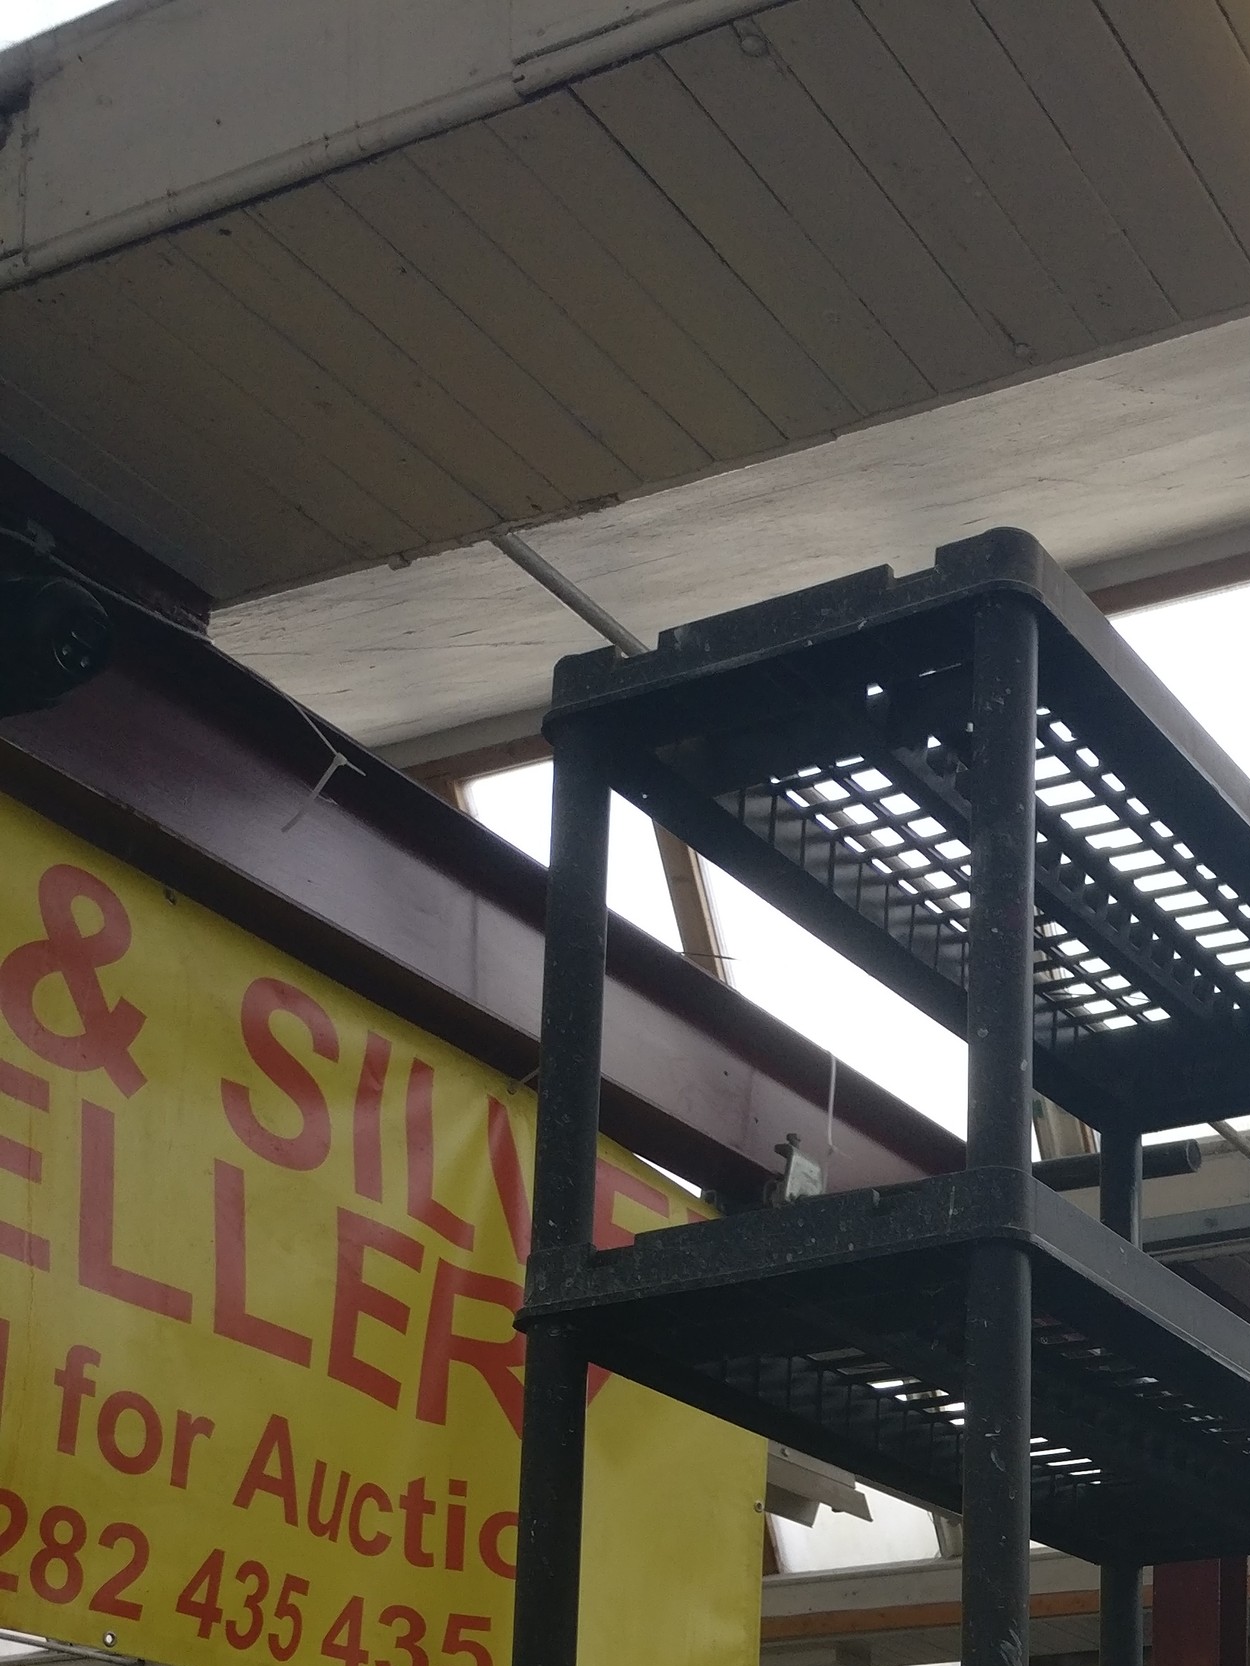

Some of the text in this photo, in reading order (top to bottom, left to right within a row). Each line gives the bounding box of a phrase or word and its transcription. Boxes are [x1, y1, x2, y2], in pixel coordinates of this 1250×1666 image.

[2, 863, 148, 1098] &
[54, 1345, 215, 1489] for
[232, 1413, 519, 1580] Auctio
[175, 1548, 311, 1662] 435
